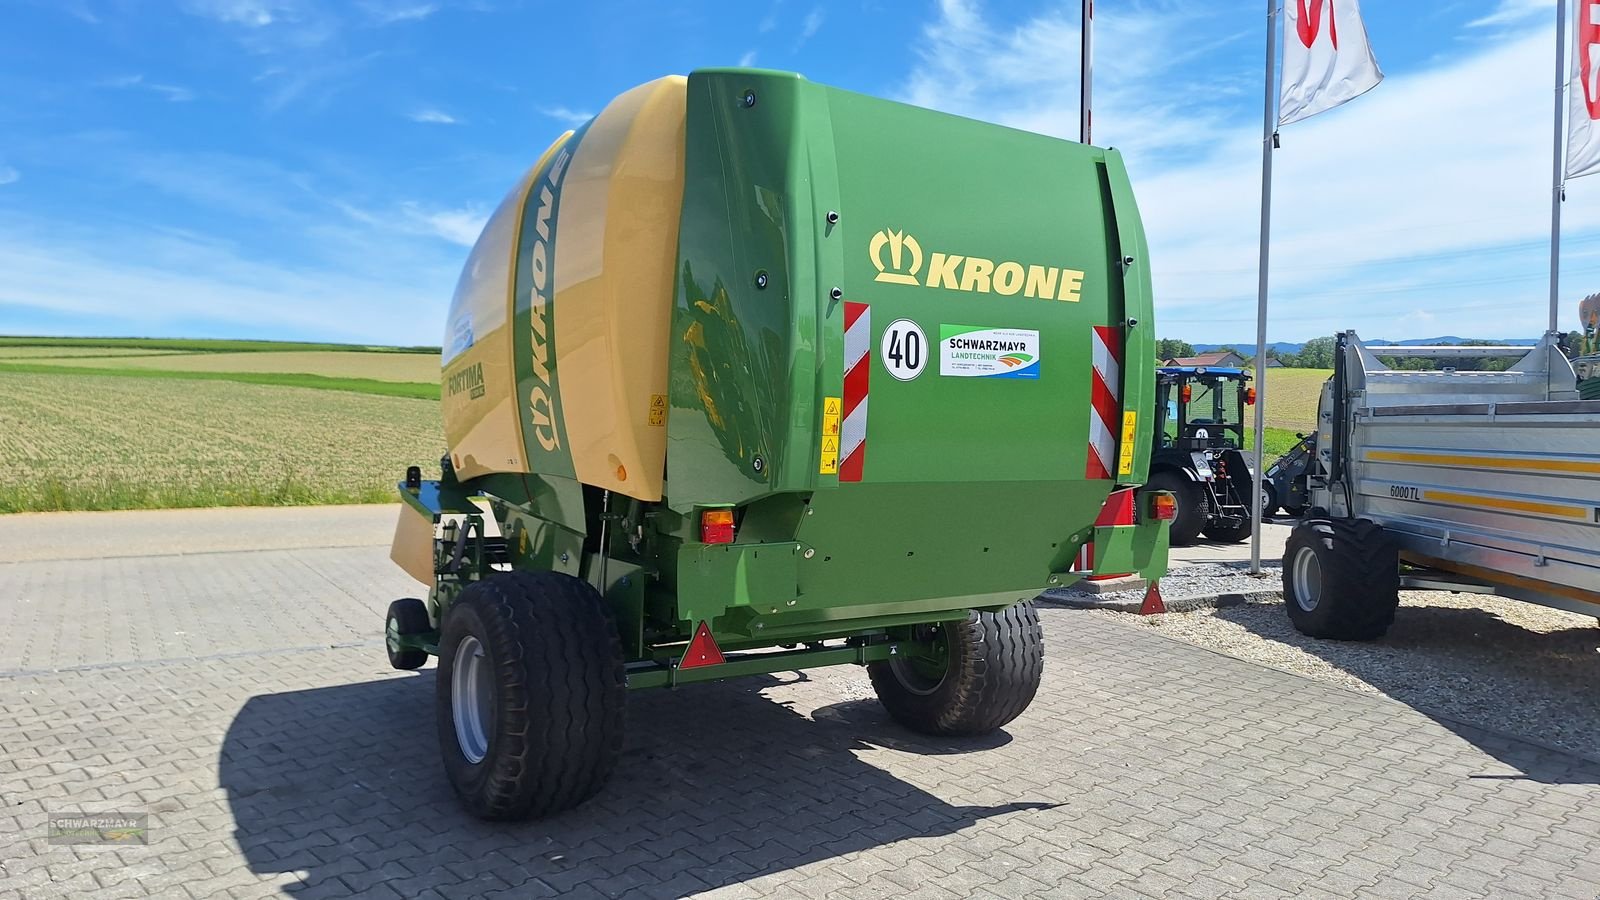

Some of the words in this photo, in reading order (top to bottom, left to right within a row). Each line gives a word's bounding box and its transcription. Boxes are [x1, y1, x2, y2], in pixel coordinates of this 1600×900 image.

[530, 147, 570, 386] KRONE
[926, 252, 1084, 302] KRONE
[888, 330, 920, 370] 40
[950, 338, 1026, 351] SCHWARZMAYR
[951, 351, 997, 361] LANDTECHNIK
[448, 362, 484, 397] FORTIMA
